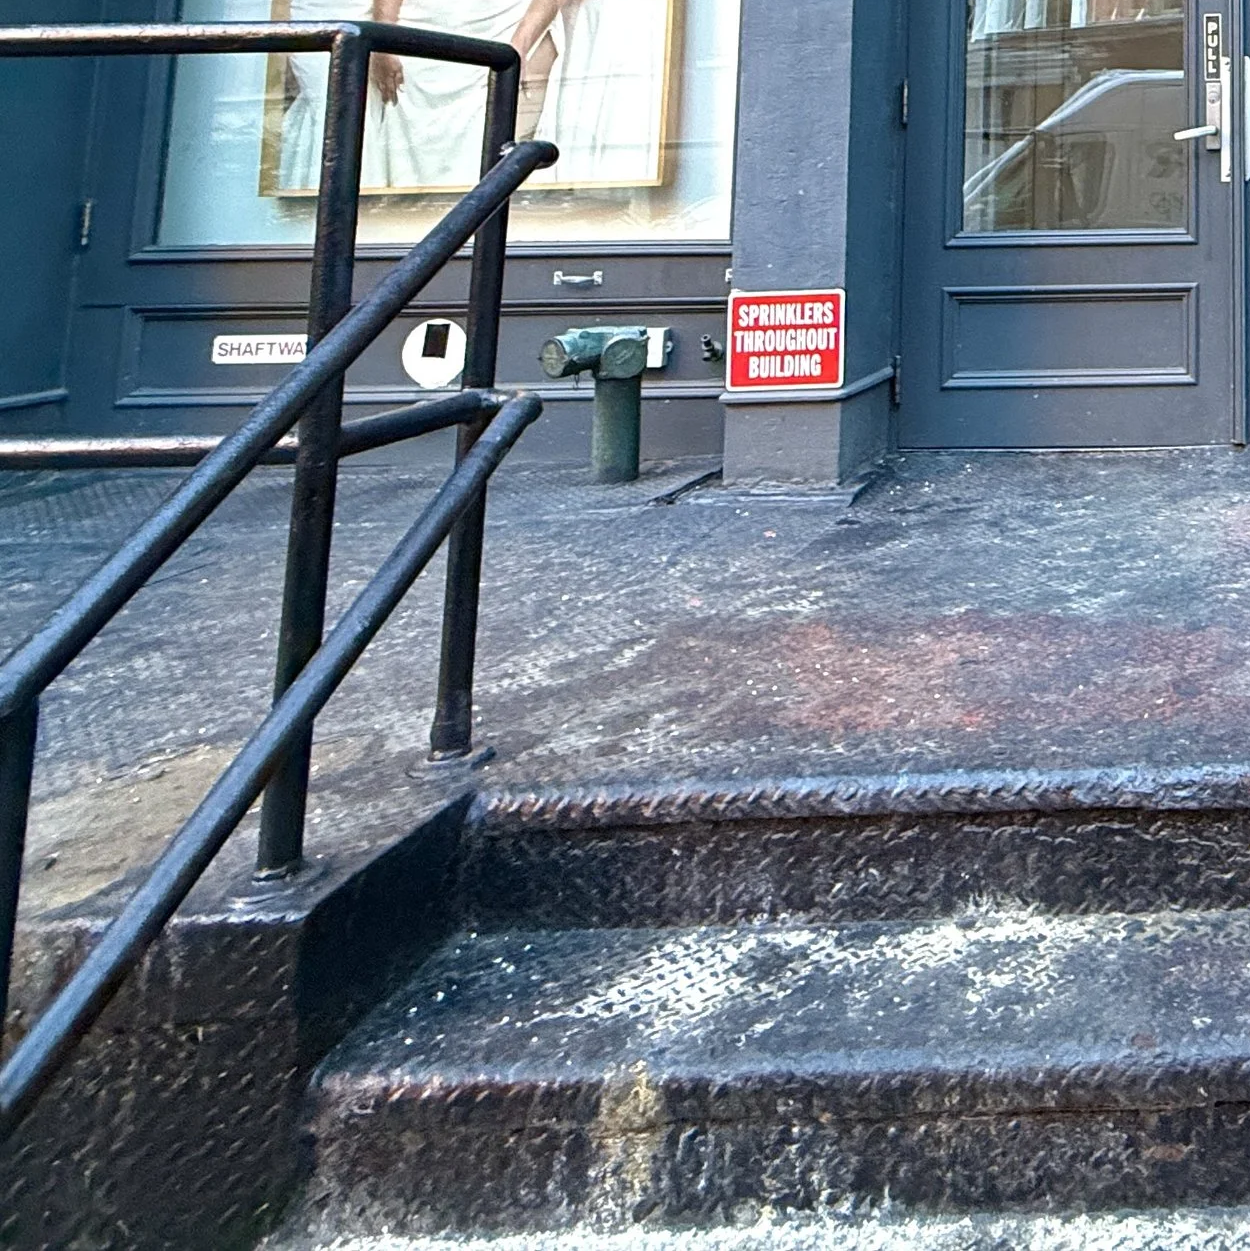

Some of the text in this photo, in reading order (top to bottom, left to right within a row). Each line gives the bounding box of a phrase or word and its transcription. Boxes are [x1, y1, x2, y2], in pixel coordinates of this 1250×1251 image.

[1206, 21, 1220, 75] PULL
[738, 301, 834, 327] SPRINKLERS
[217, 341, 307, 357] SHAFTWA
[733, 327, 838, 353] THROUGHOUT
[748, 353, 822, 379] BUILDING
